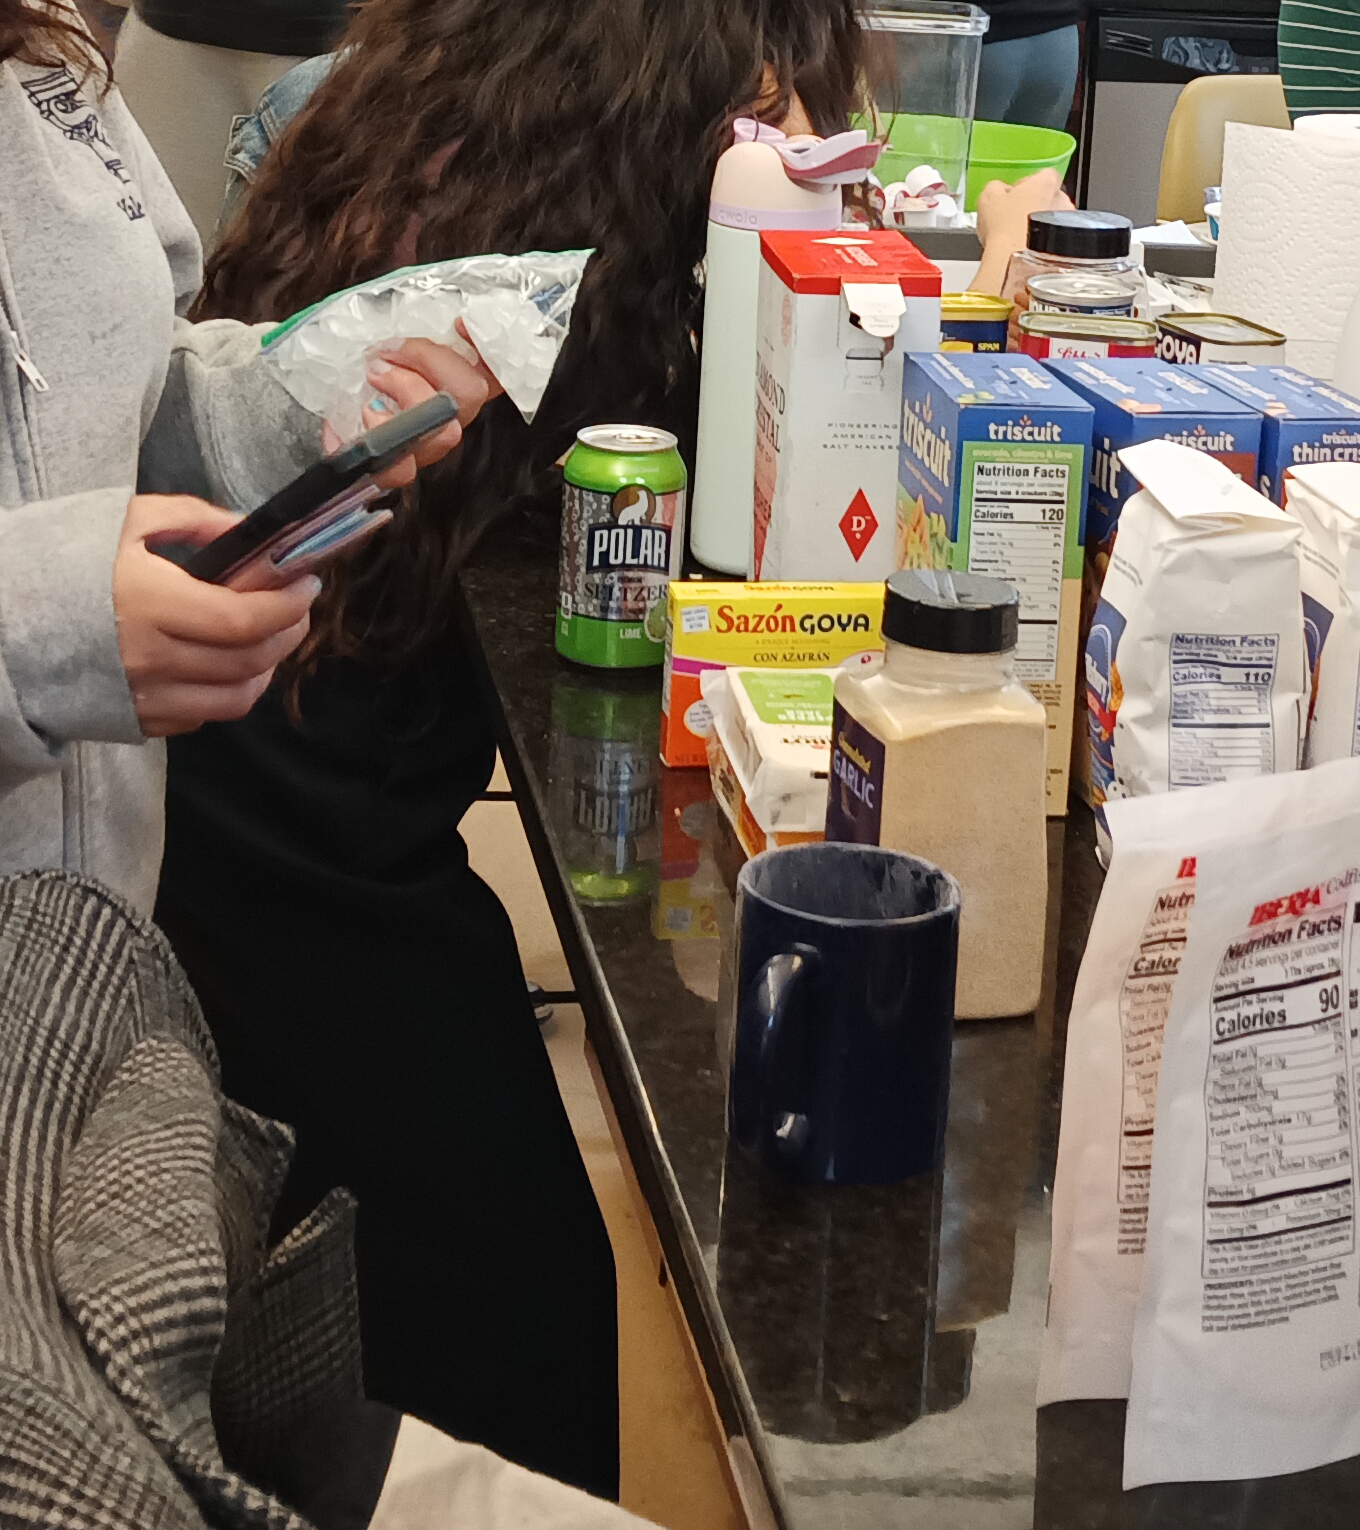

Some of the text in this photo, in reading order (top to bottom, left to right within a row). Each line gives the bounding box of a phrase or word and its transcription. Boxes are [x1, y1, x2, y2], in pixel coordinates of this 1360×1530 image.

[988, 420, 1062, 441] triscuit
[903, 399, 951, 487] triscuit
[1293, 442, 1331, 462] thin
[976, 465, 1066, 478] Nutrition Facts
[974, 508, 1064, 521] Calories 120
[592, 528, 666, 568] POLAR
[716, 603, 796, 633] Sazón
[799, 614, 870, 635] GOYA
[619, 628, 641, 639] LIME
[1175, 636, 1276, 647] Nutrition Facts
[753, 651, 830, 663] CON AZAFRÁN
[1172, 671, 1272, 683] Calories 110
[833, 748, 875, 808] GARLIC
[1226, 916, 1342, 962] Nutrition Facts
[1214, 984, 1340, 1037] Calories 90
